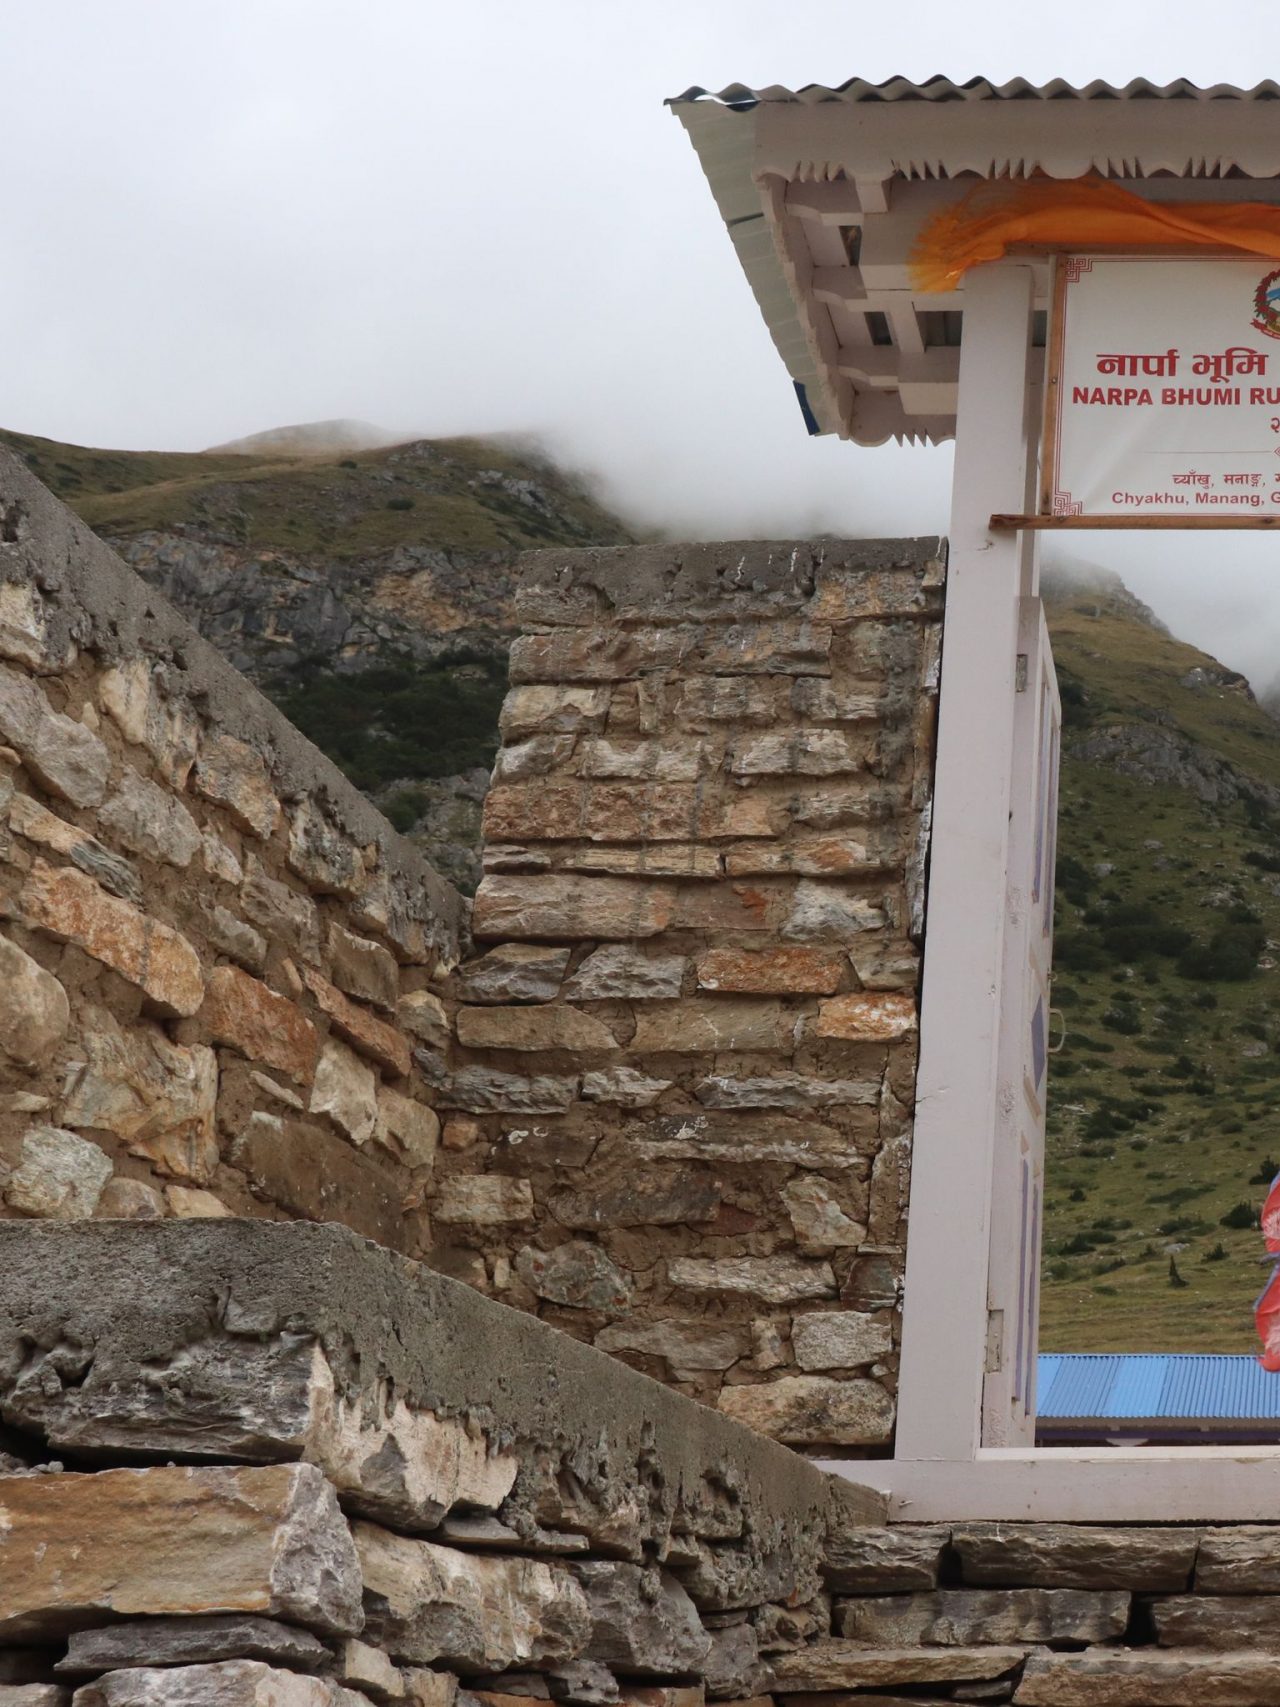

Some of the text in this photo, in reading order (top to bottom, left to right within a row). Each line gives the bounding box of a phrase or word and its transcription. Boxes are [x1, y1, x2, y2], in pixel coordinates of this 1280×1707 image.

[1095, 348, 1182, 379] नार्पा
[1191, 346, 1269, 384] भूमि
[1071, 385, 1154, 407] NARPA
[1160, 387, 1242, 407] BHUMI
[1111, 492, 1190, 507] Chyakhu,
[1194, 493, 1265, 508] Manang,
